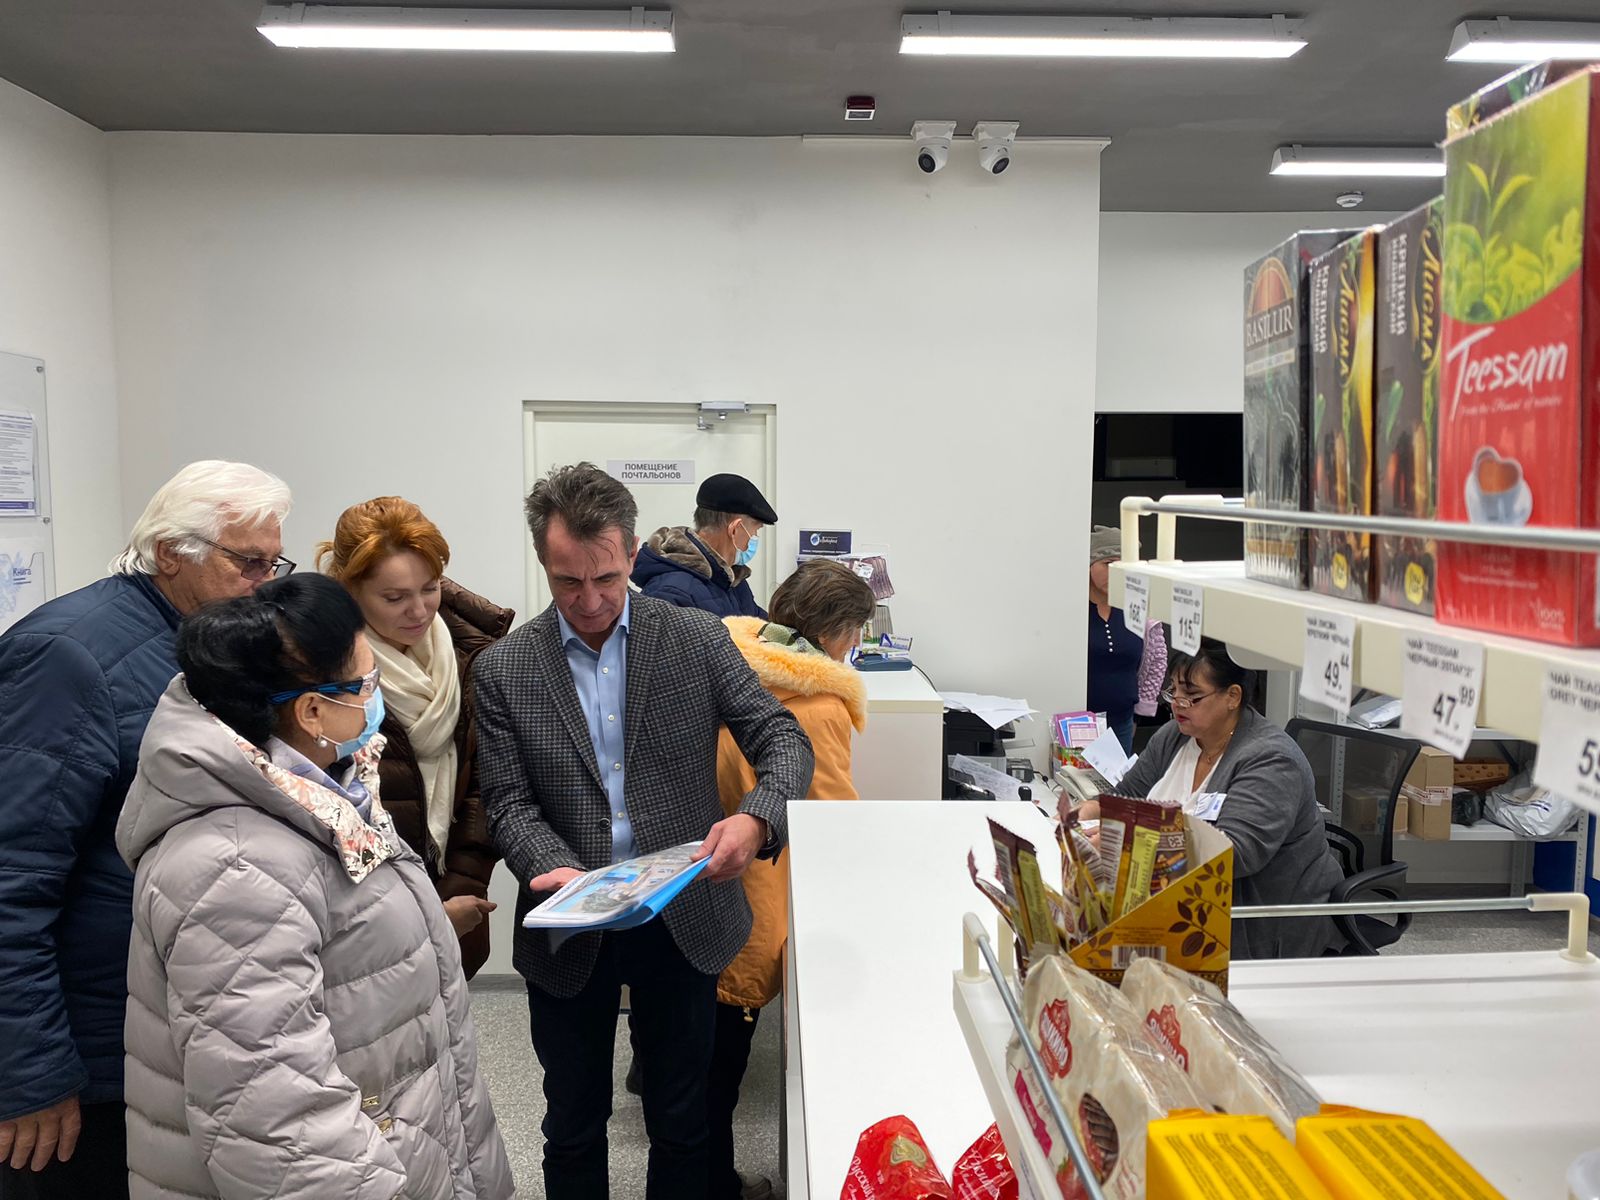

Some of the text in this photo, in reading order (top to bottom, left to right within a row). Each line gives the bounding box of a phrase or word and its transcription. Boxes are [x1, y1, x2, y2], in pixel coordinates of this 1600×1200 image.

[1319, 265, 1330, 353] КРЕПКИЙ
[1396, 234, 1407, 336] КРЕПКИЙ
[1446, 326, 1568, 422] Teessam
[621, 471, 681, 479] ПОЧТАЛЬОНОВ
[624, 463, 678, 471] ПОМЕЩЕНИЕ
[1579, 738, 1600, 783] 5
